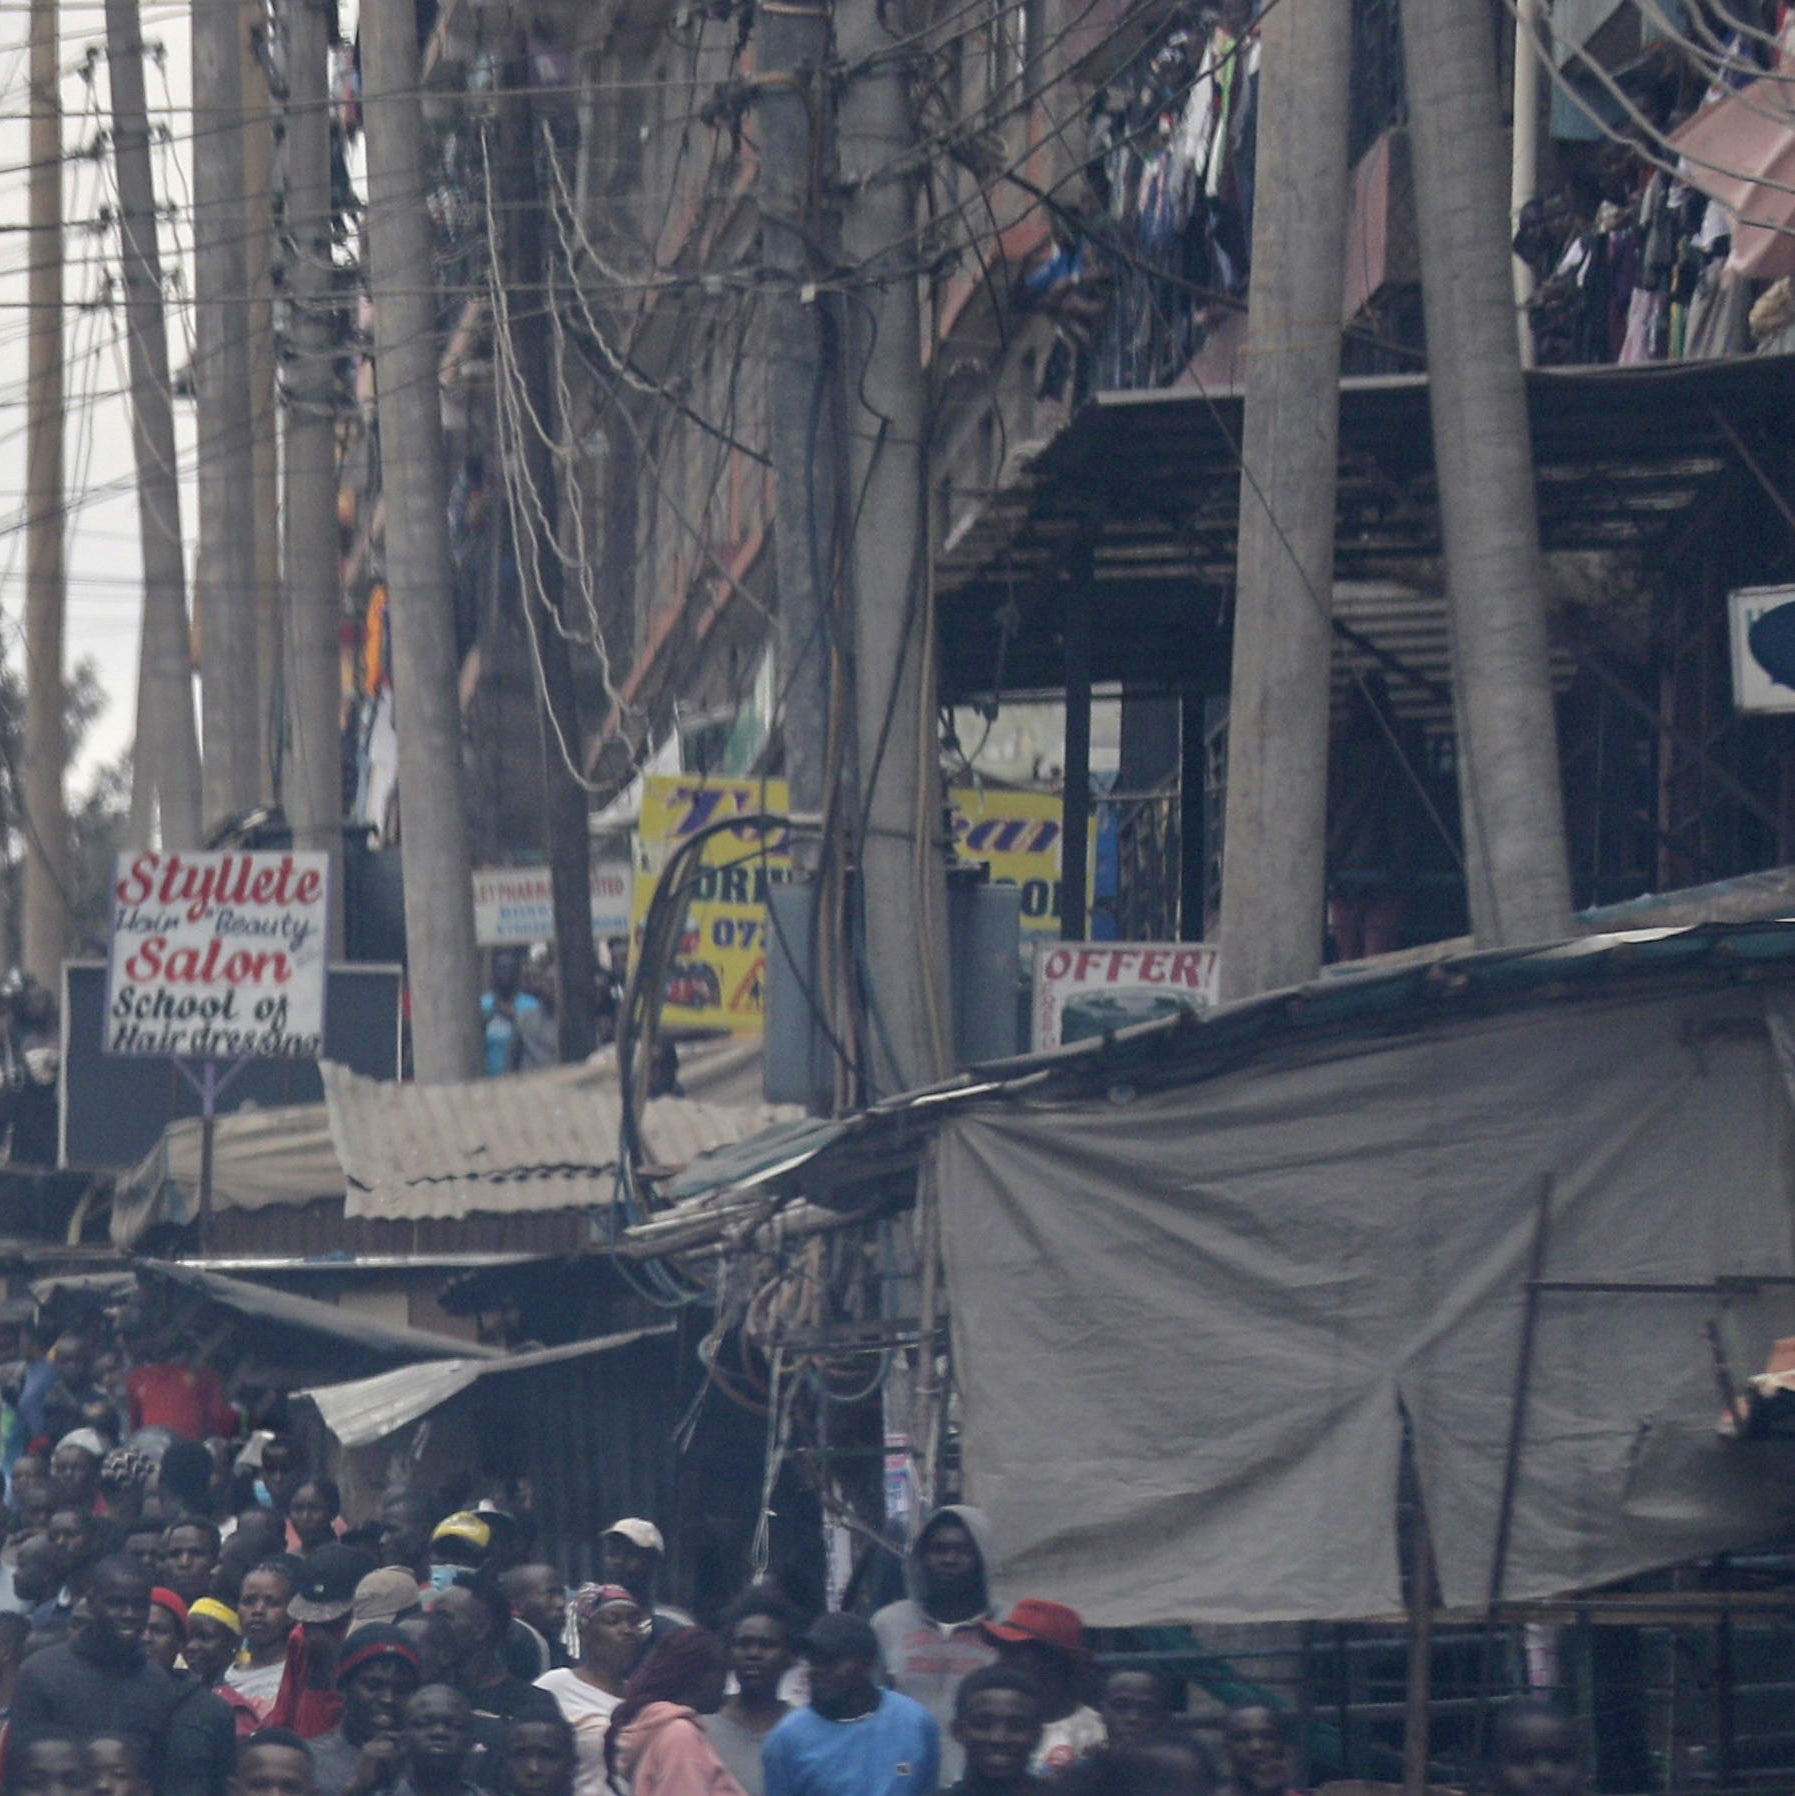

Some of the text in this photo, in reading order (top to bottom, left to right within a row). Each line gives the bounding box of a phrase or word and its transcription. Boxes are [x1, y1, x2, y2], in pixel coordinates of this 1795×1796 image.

[115, 853, 321, 924] Styllete
[116, 908, 179, 932] Hair
[125, 936, 292, 985] Salon
[112, 985, 288, 1034] School of
